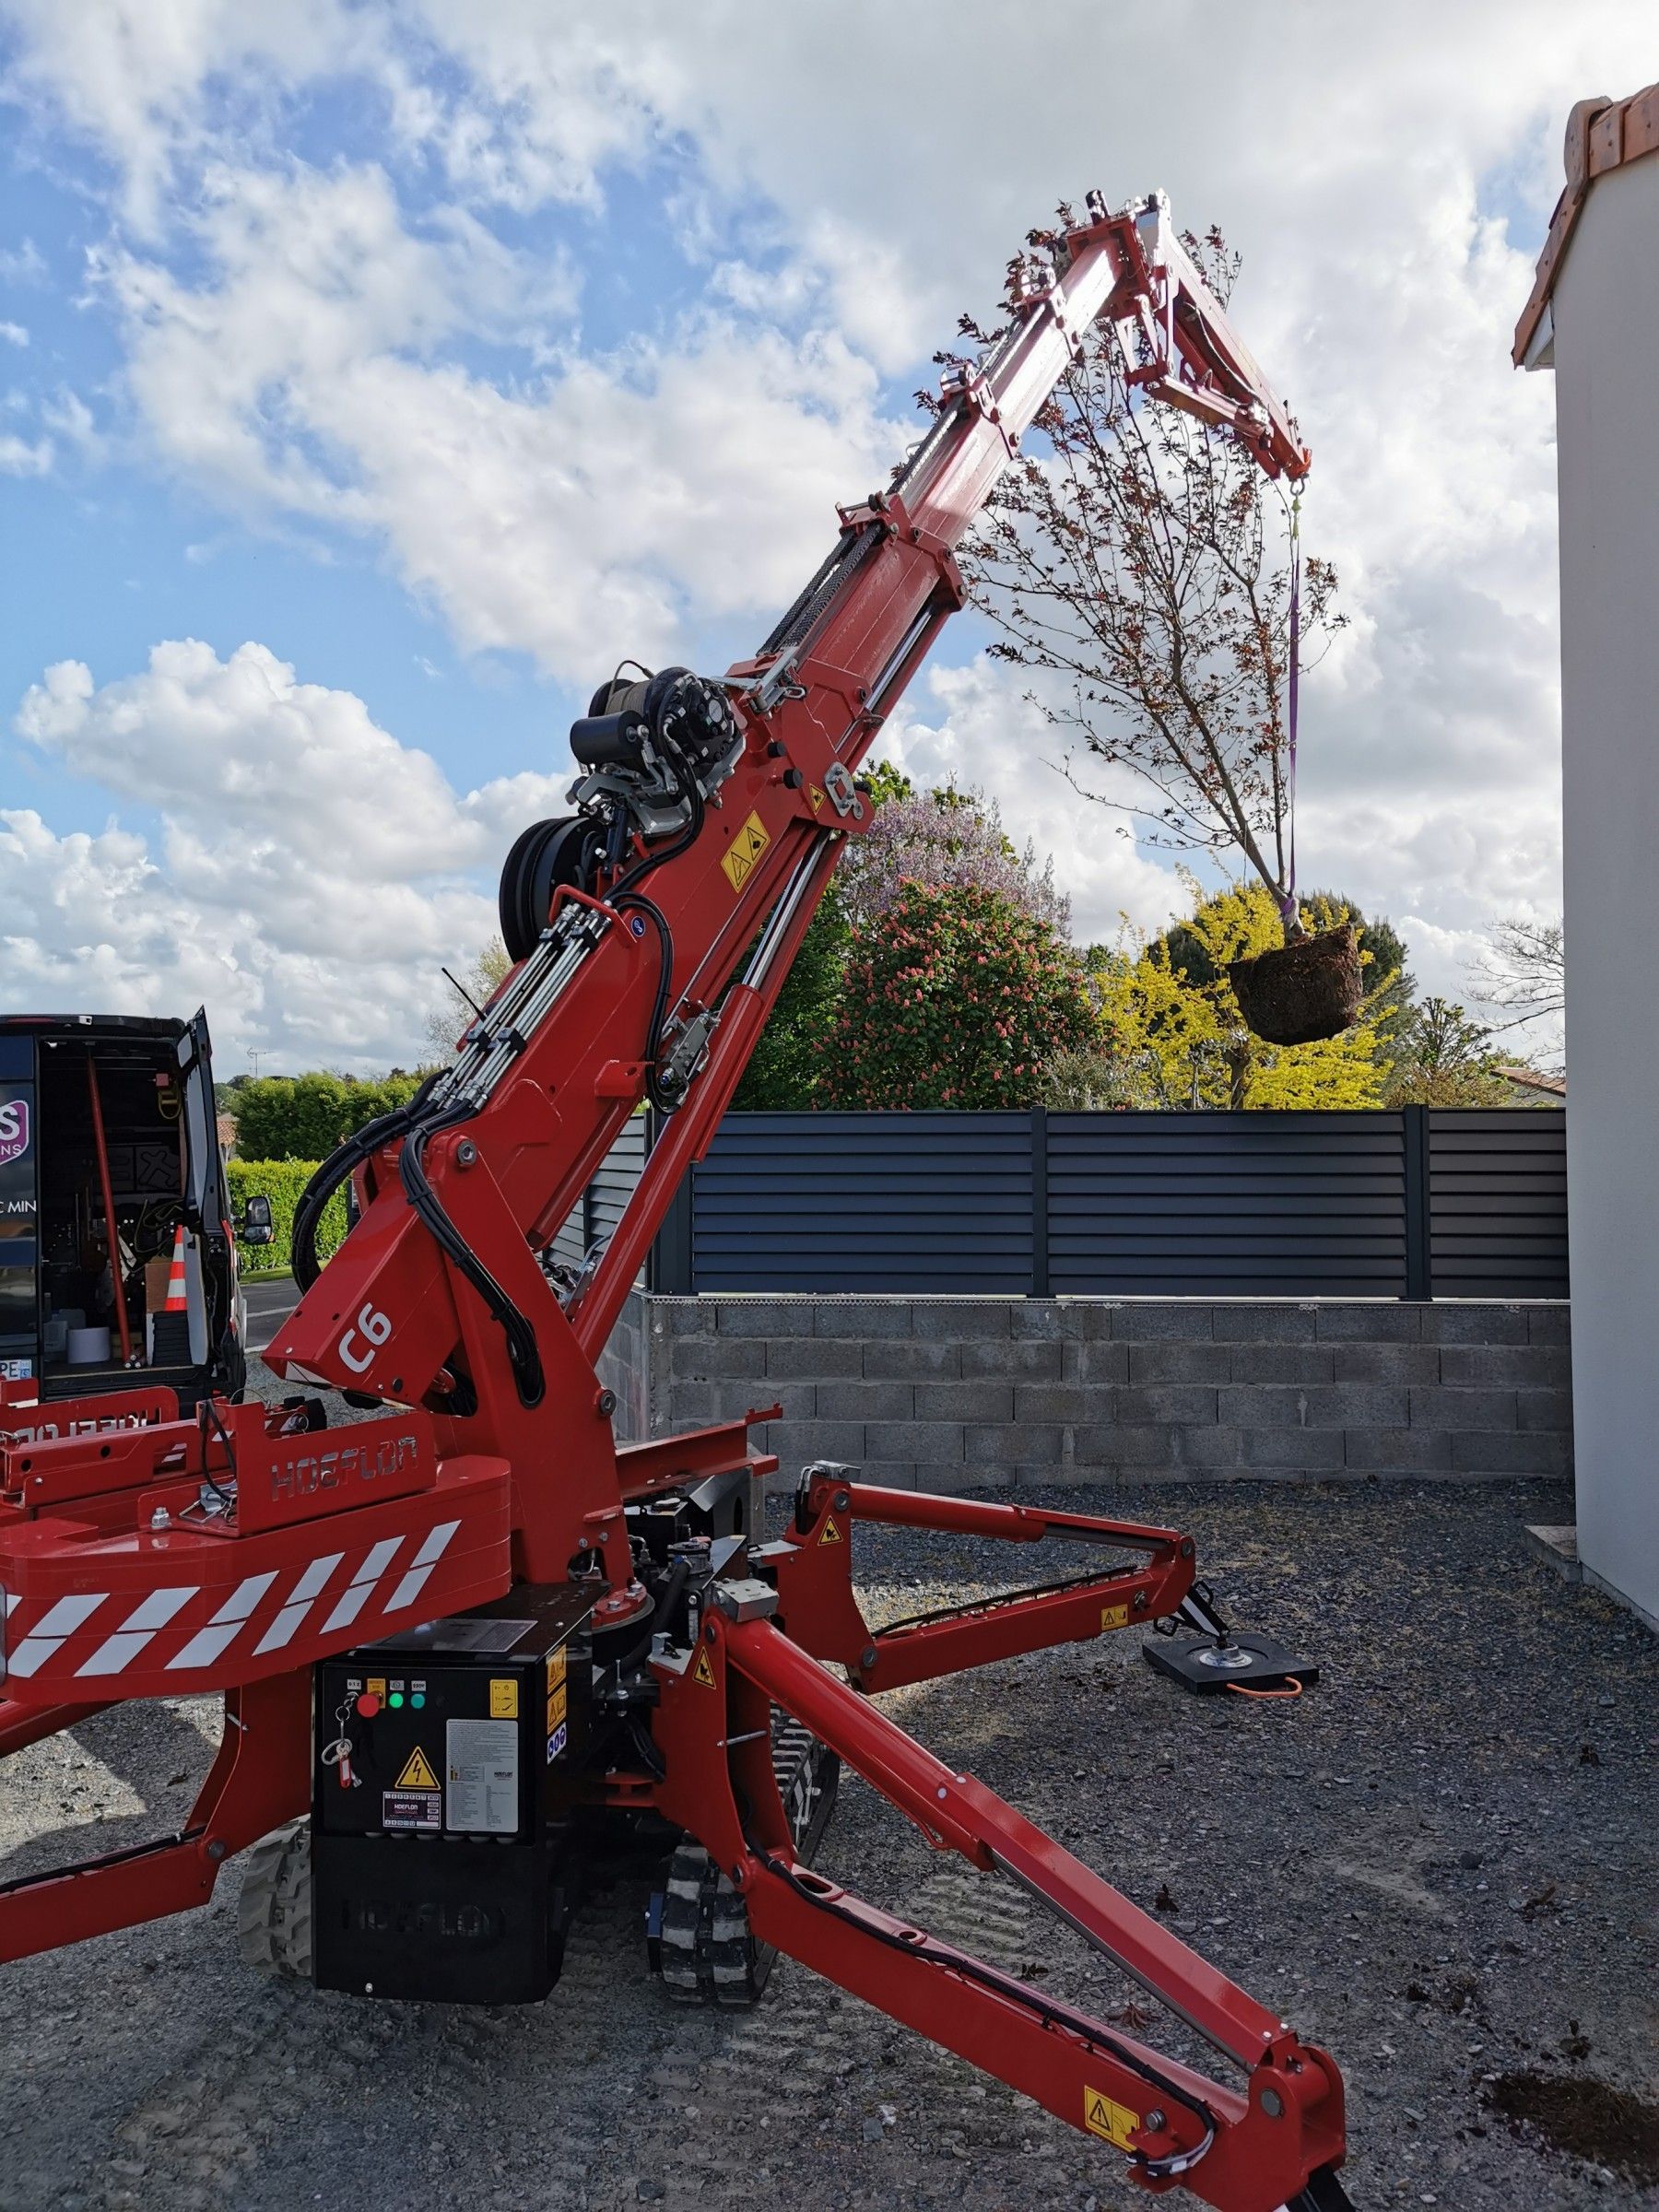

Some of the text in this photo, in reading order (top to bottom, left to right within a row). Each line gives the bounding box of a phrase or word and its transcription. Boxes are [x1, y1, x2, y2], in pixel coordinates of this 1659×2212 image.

[6, 1200, 37, 1214] MIN
[338, 1301, 392, 1373] C6
[271, 1436, 418, 1502] HOEFLON
